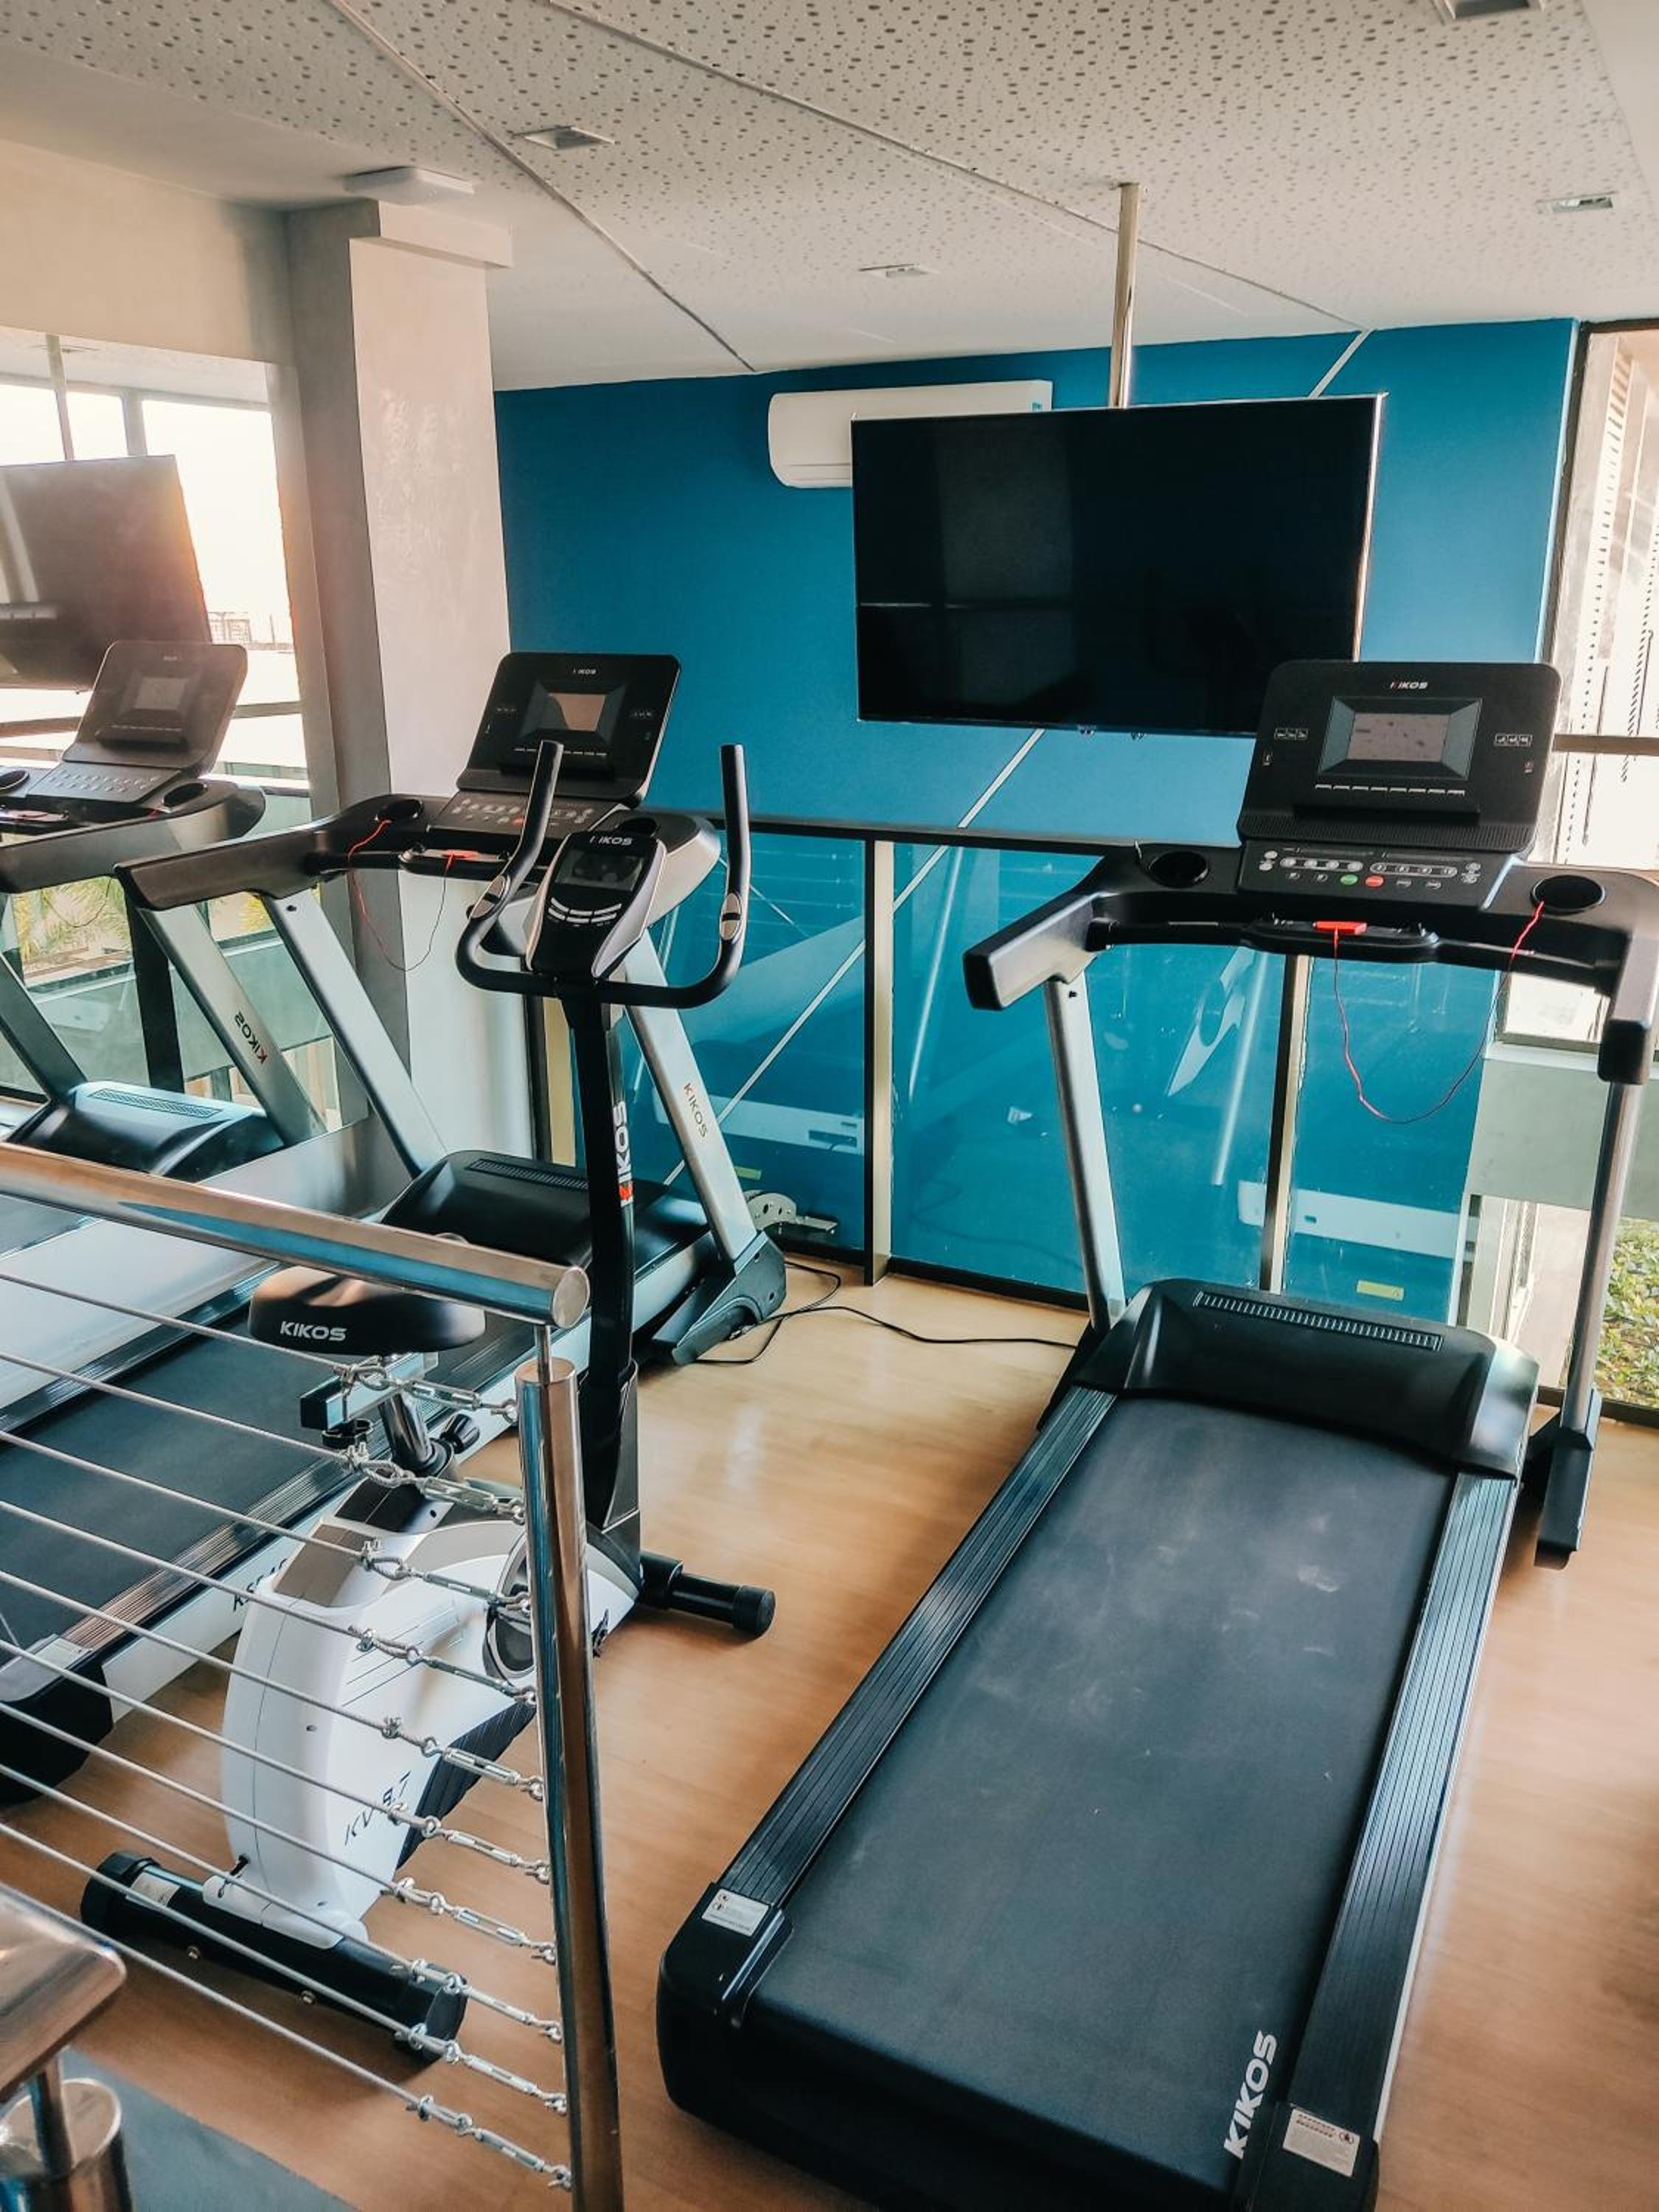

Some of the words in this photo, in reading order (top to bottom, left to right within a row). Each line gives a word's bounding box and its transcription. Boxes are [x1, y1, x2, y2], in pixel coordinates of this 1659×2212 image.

[684, 1082, 709, 1138] KIKOS
[279, 1321, 347, 1341] KIKOS
[1223, 2029, 1278, 2160] KIKOS
